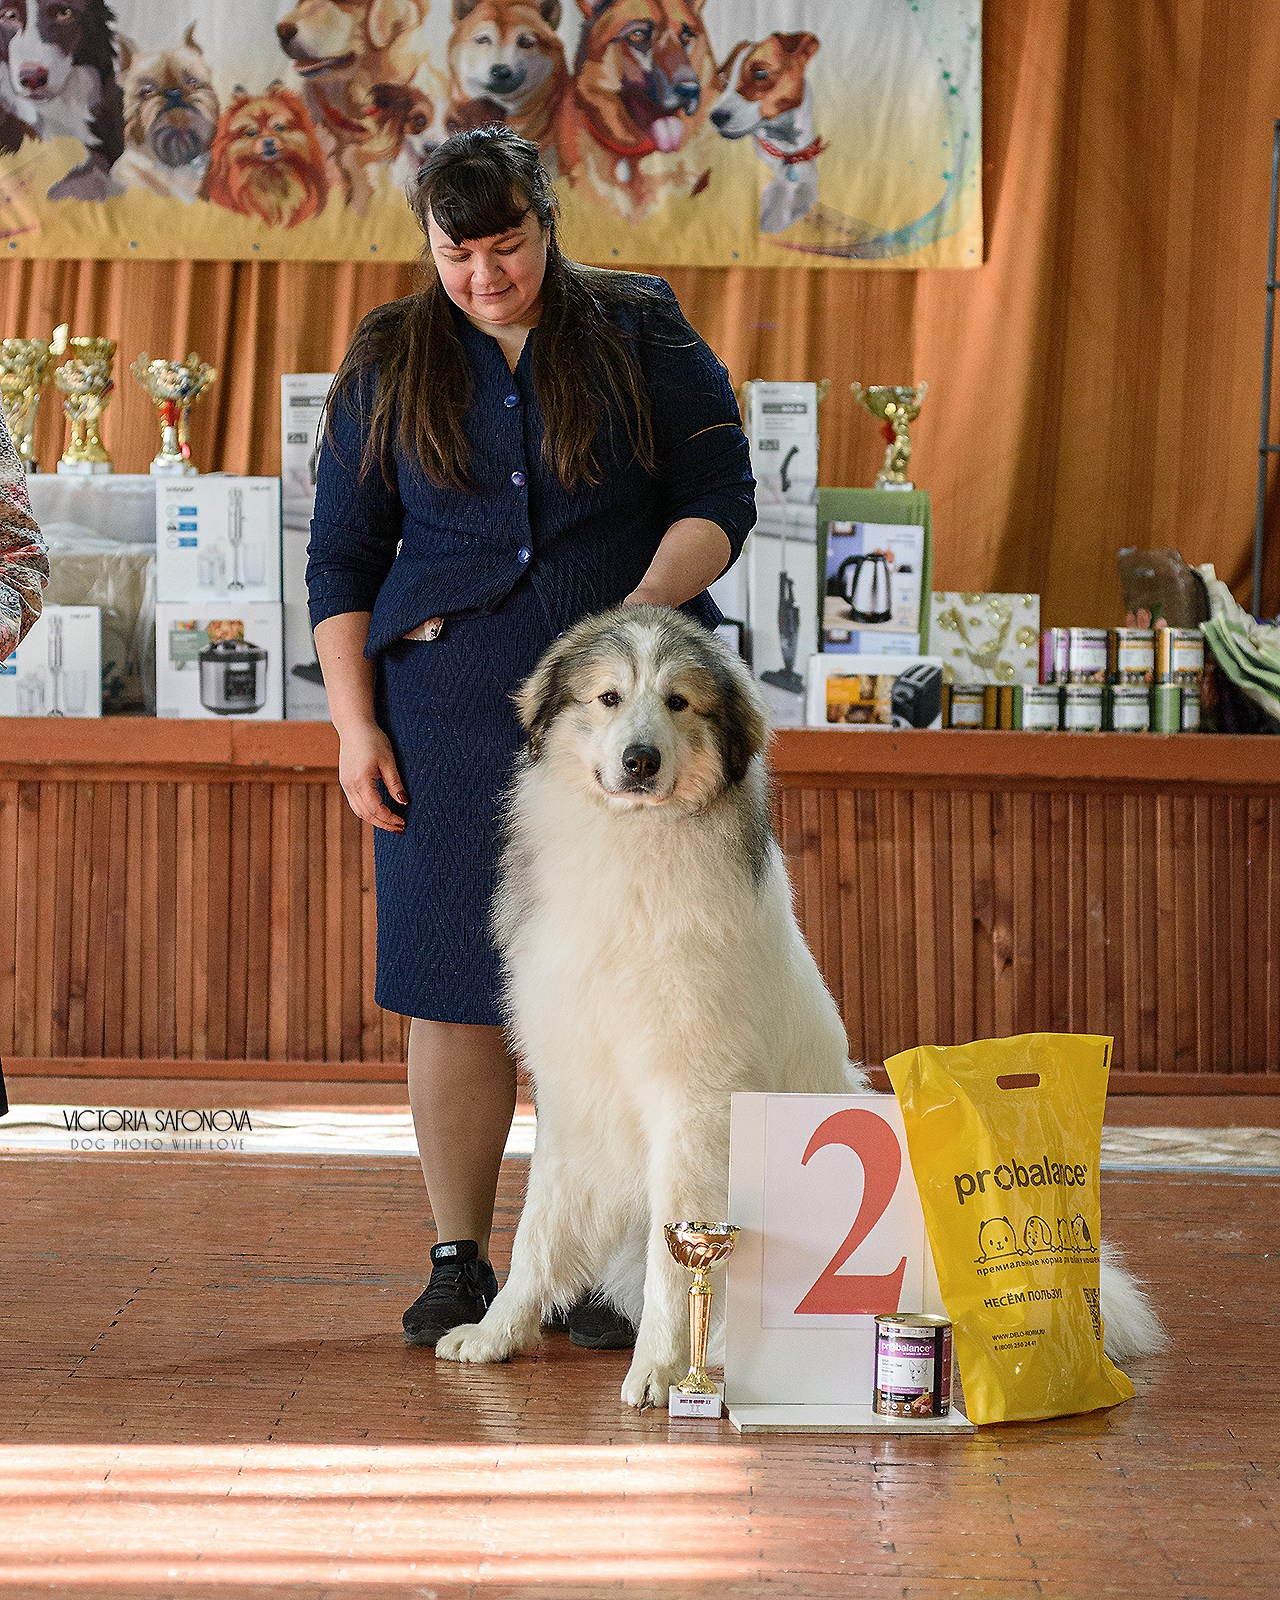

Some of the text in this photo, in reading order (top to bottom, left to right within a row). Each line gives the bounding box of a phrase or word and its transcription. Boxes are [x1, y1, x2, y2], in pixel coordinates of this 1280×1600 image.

[954, 1155, 1087, 1205] probalance
[793, 1108, 907, 1315] 2
[976, 1258, 1040, 1277] премиальные
[983, 1288, 1063, 1308] НЕСЁМ ПОЛЬЗУ!
[881, 1342, 930, 1353] probalance
